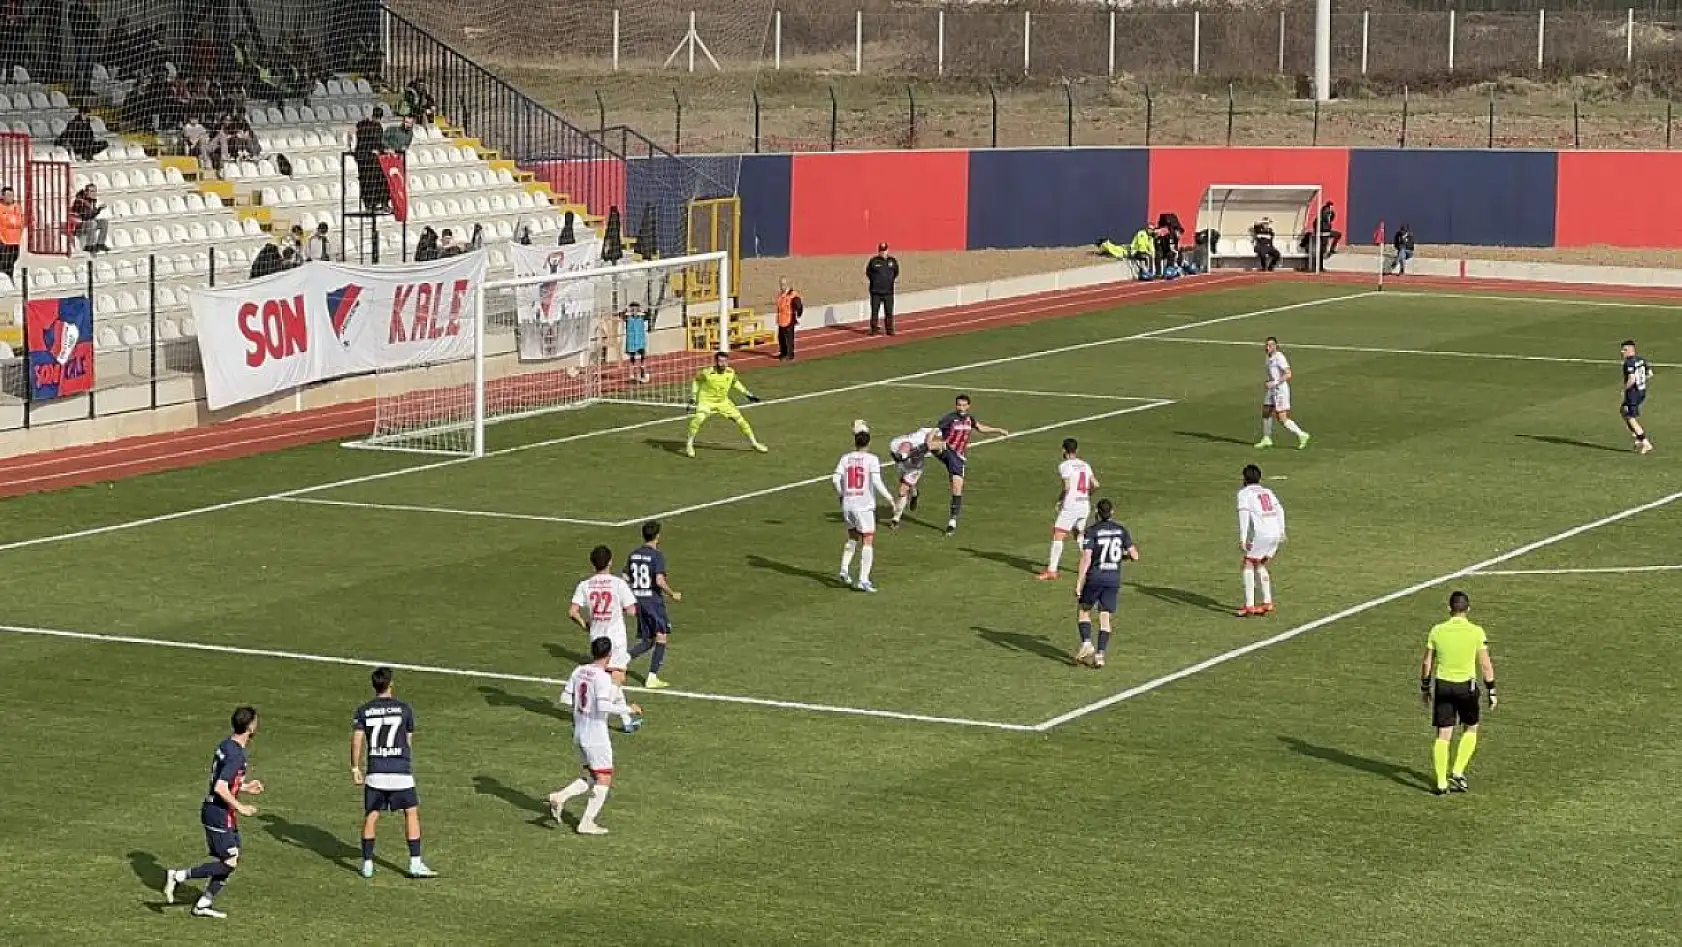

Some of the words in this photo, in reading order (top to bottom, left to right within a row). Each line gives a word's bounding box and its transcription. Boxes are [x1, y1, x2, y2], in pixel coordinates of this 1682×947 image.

[237, 294, 308, 368] SON
[388, 279, 469, 345] KALE
[35, 364, 60, 385] SON
[846, 467, 865, 490] 16
[1077, 472, 1091, 494] 4
[1258, 493, 1273, 512] 10
[1097, 537, 1122, 563] 76
[589, 591, 613, 616] 22
[366, 717, 402, 747] 77
